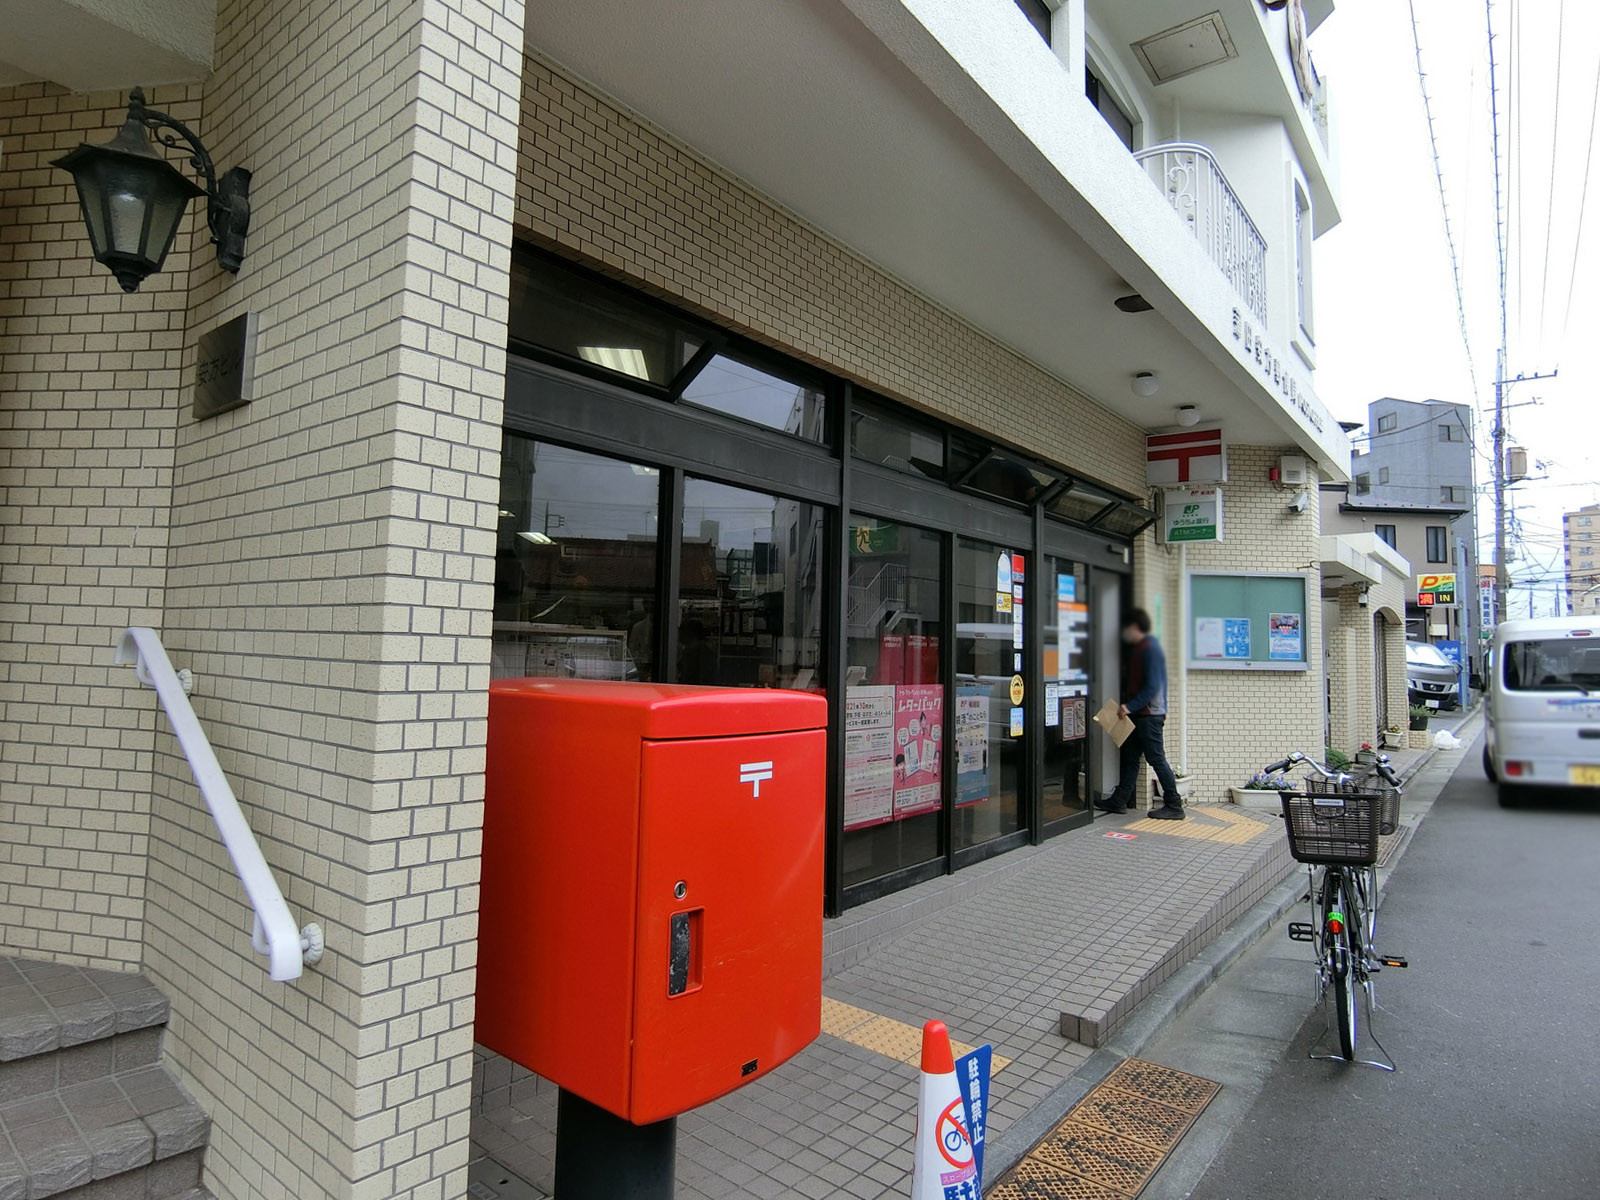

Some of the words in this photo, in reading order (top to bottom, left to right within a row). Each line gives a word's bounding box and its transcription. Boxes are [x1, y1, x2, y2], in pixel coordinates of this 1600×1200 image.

[1173, 518, 1209, 526] ゆうちょ銀行
[1420, 576, 1439, 589] P
[1439, 594, 1451, 602] IN
[898, 696, 942, 713] レターパック
[967, 1056, 984, 1146] 駐輪禁止
